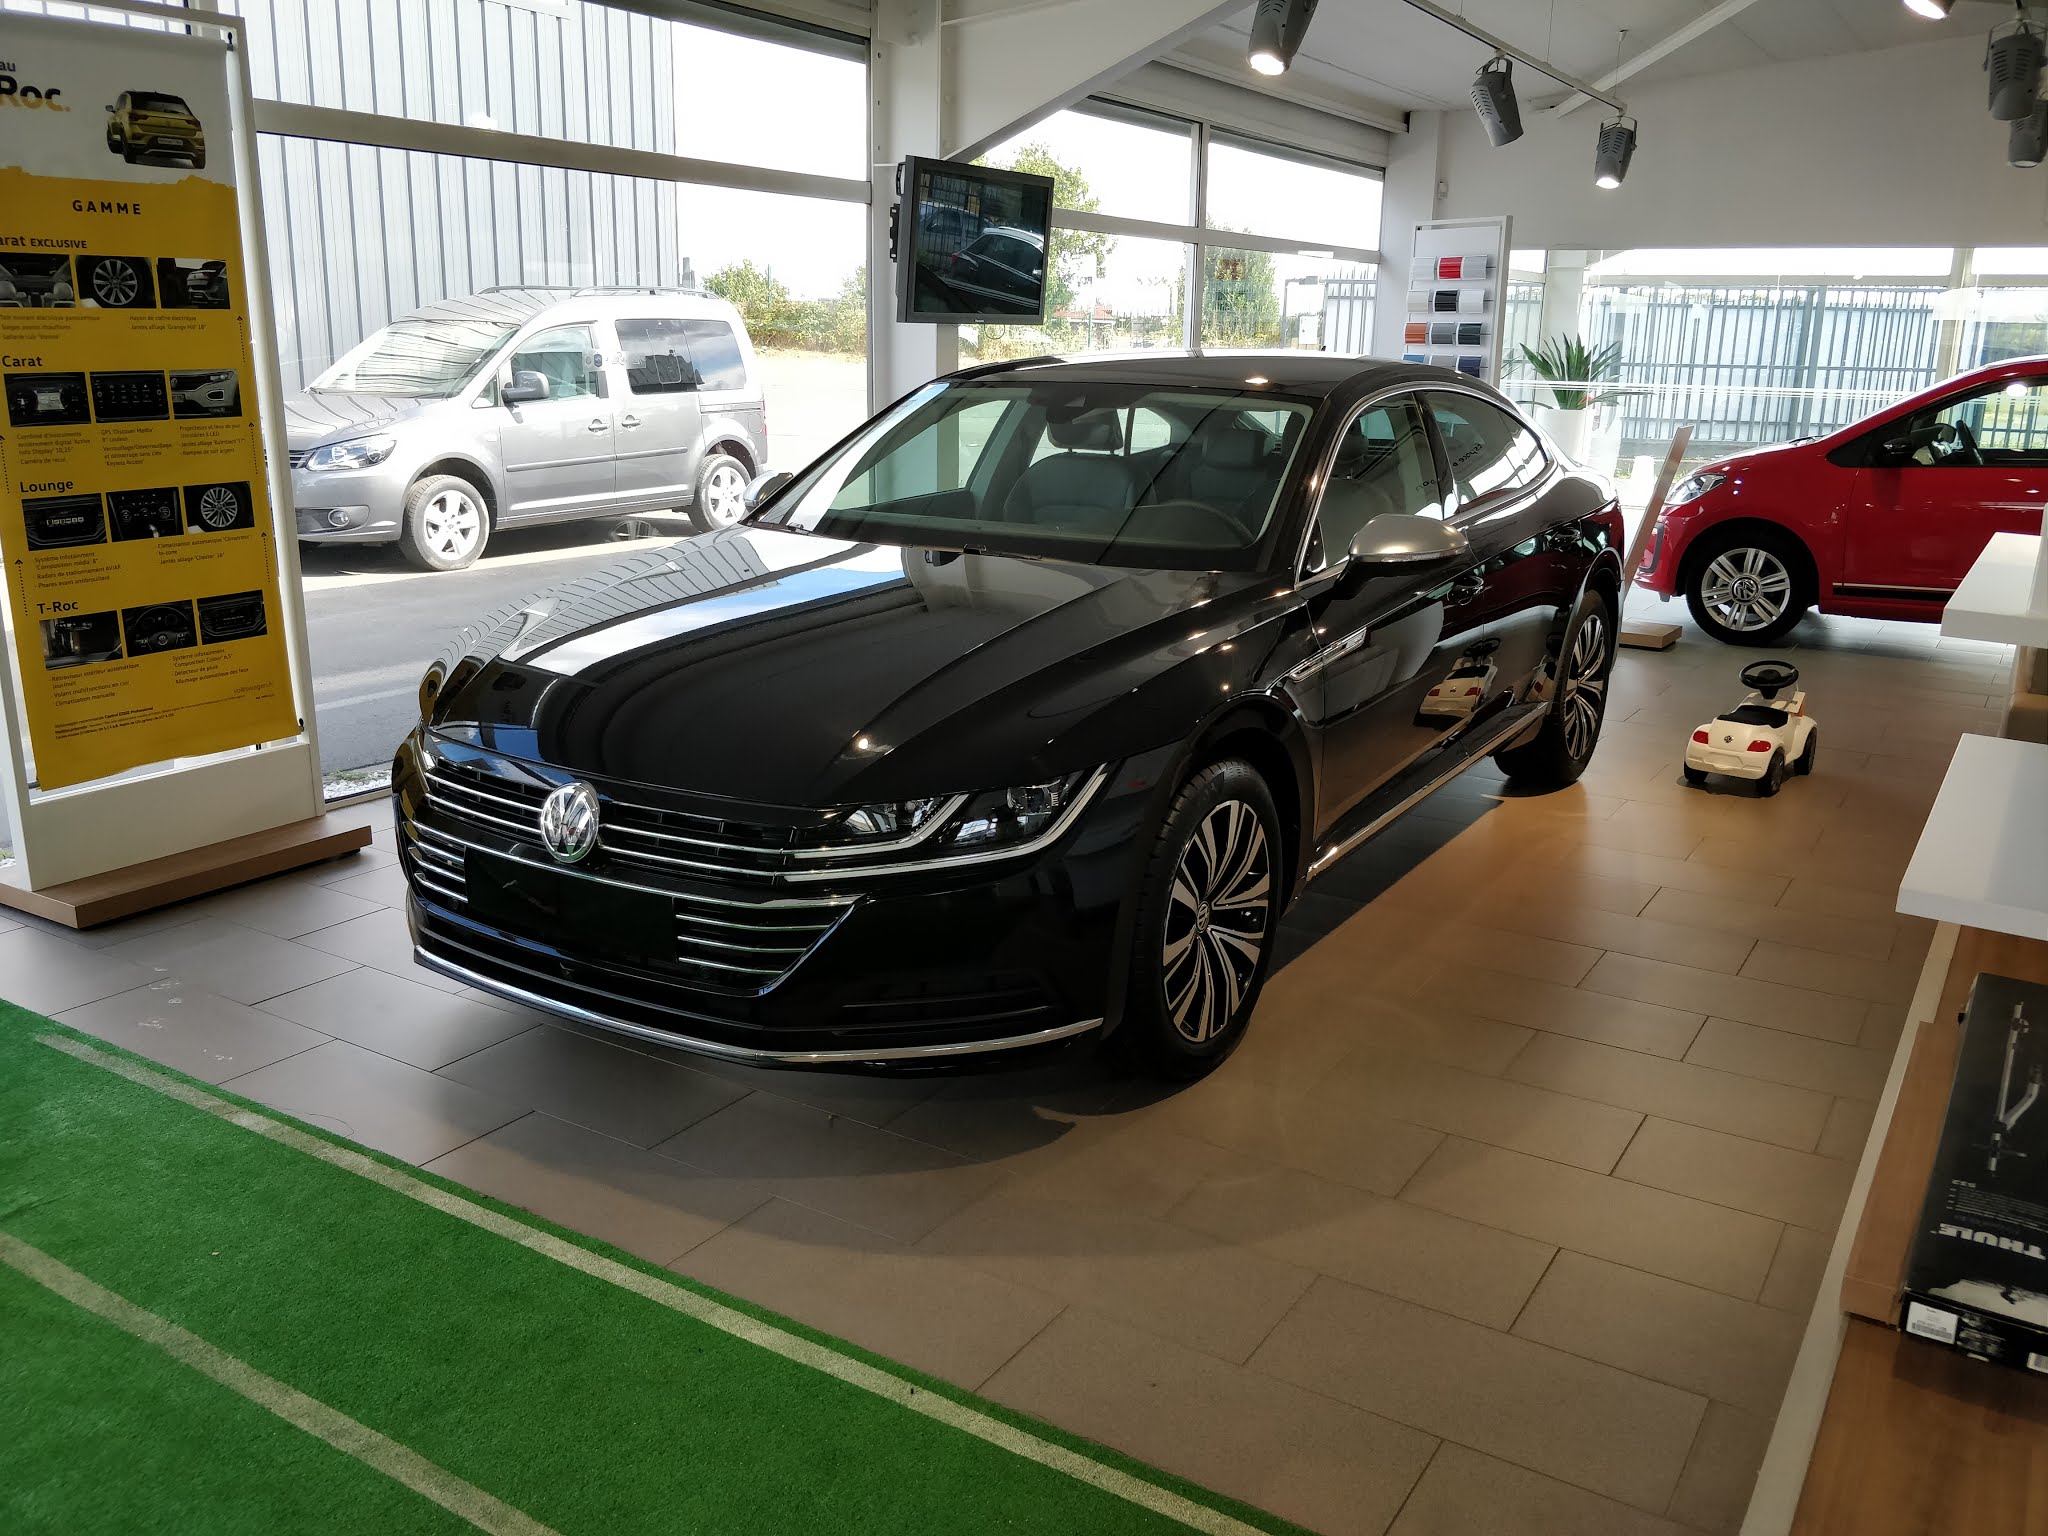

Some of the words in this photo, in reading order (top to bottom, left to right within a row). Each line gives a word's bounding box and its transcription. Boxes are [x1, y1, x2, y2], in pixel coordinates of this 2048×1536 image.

[72, 199, 142, 215] GAMME
[30, 238, 87, 249] EXCLUSIVE
[1, 355, 43, 368] Carat
[20, 481, 74, 493] Lounge
[36, 601, 79, 614] T-Roc
[1938, 1222, 2046, 1261] THULE
